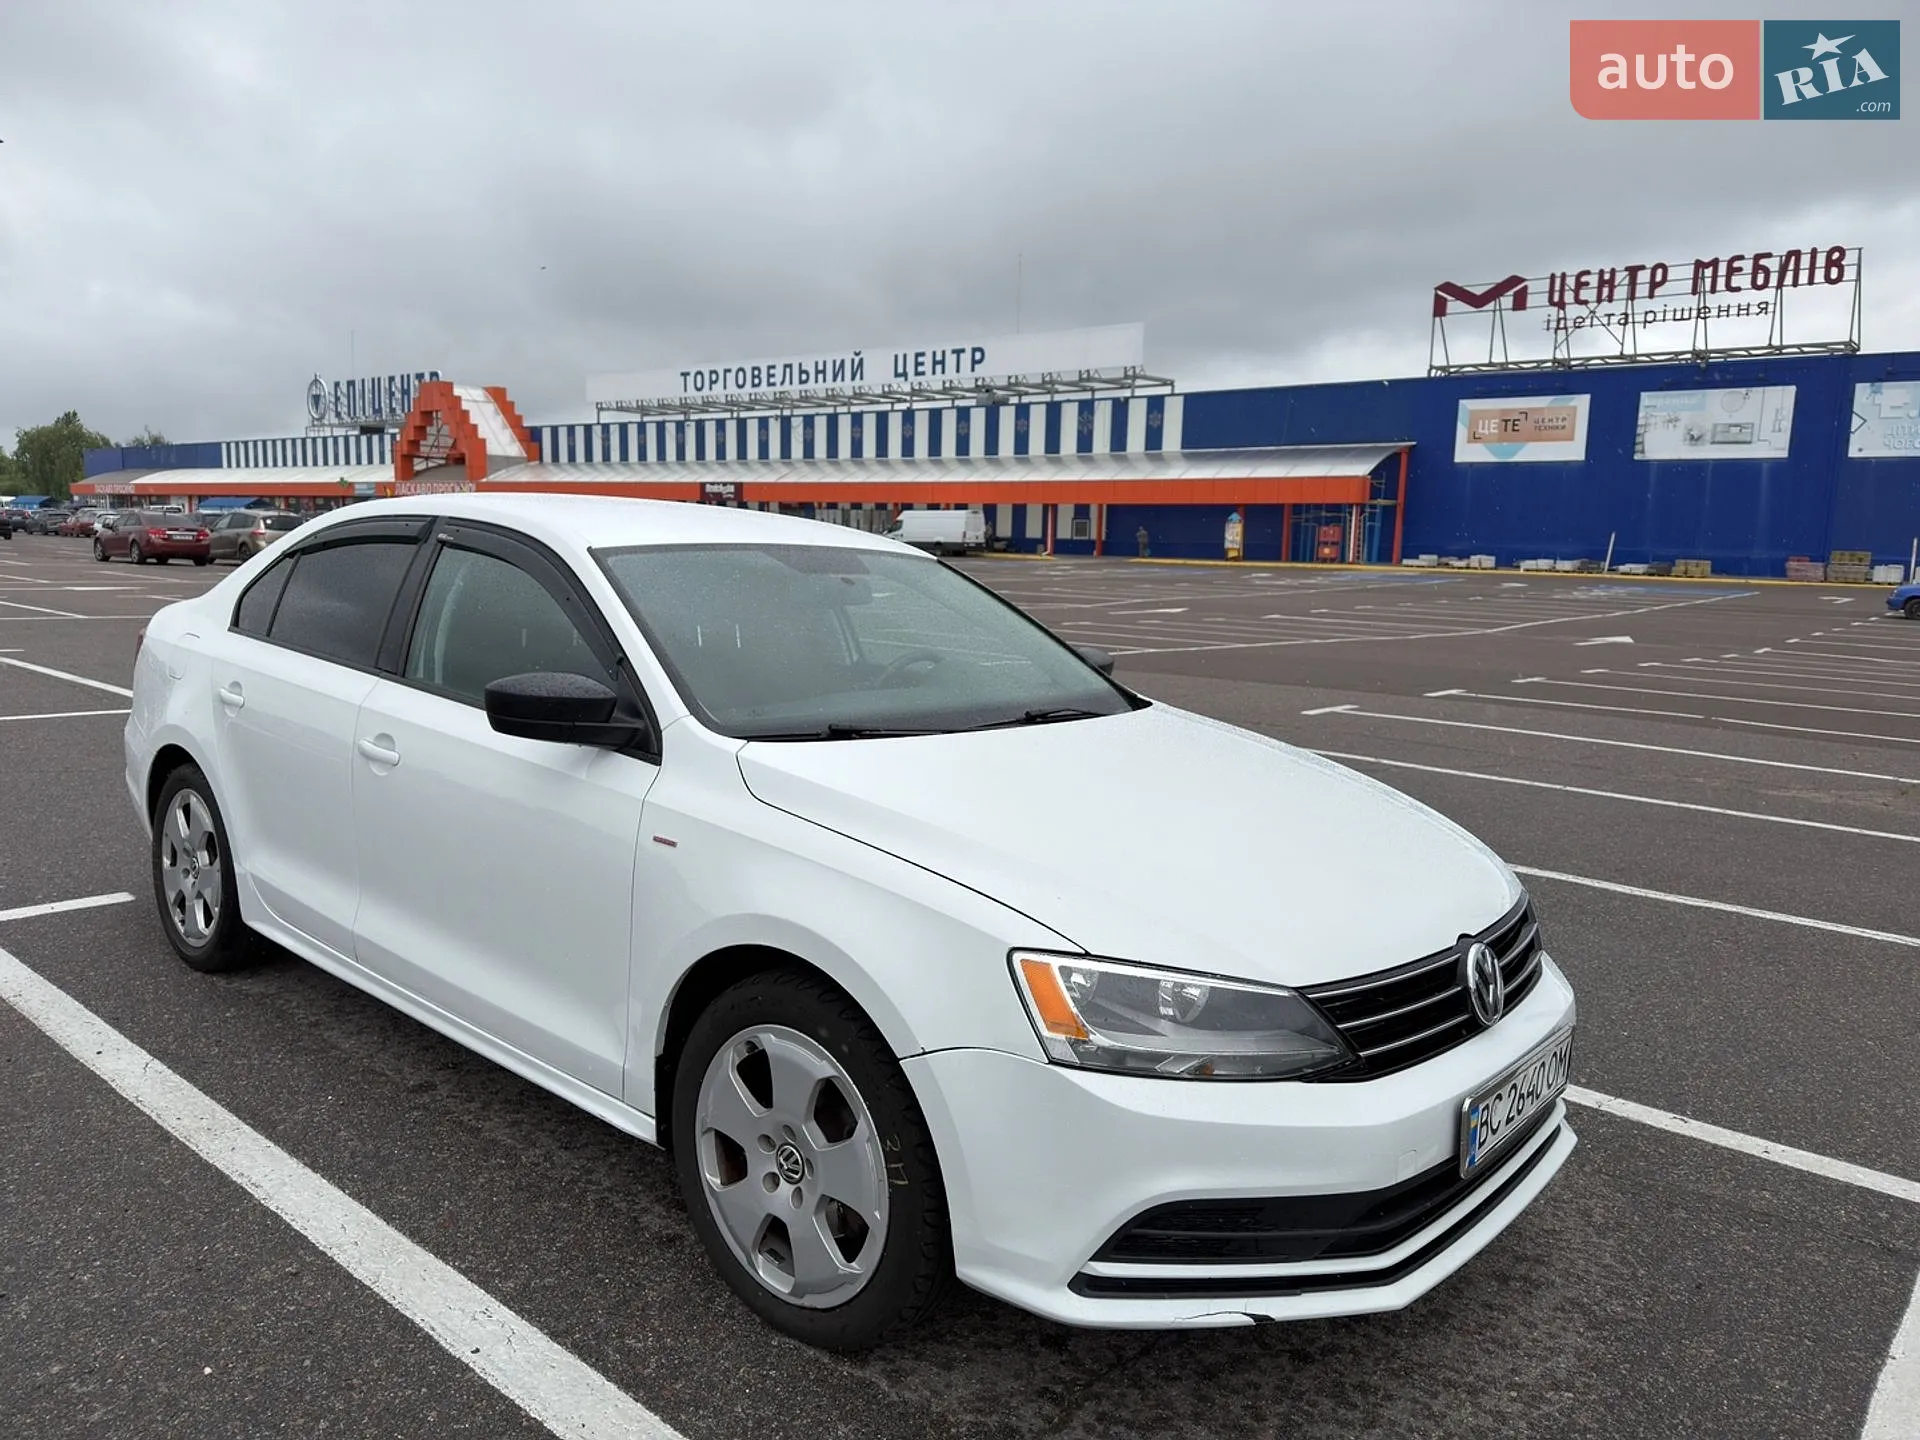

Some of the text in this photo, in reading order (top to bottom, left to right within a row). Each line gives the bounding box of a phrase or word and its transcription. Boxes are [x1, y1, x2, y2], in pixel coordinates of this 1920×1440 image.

[1547, 245, 1847, 310] ЦЕНТР МЕБЛІВ
[1604, 311, 1630, 327] та
[1643, 300, 1771, 329] рішення
[680, 346, 986, 393] ТОРГОВЕЛЬНИЙ ЦЕНТР
[333, 370, 442, 421] ЕПІЦЕН
[1533, 416, 1567, 424] ЦЕНТР
[1478, 1092, 1503, 1150] BC
[1505, 1060, 1547, 1126] 2640
